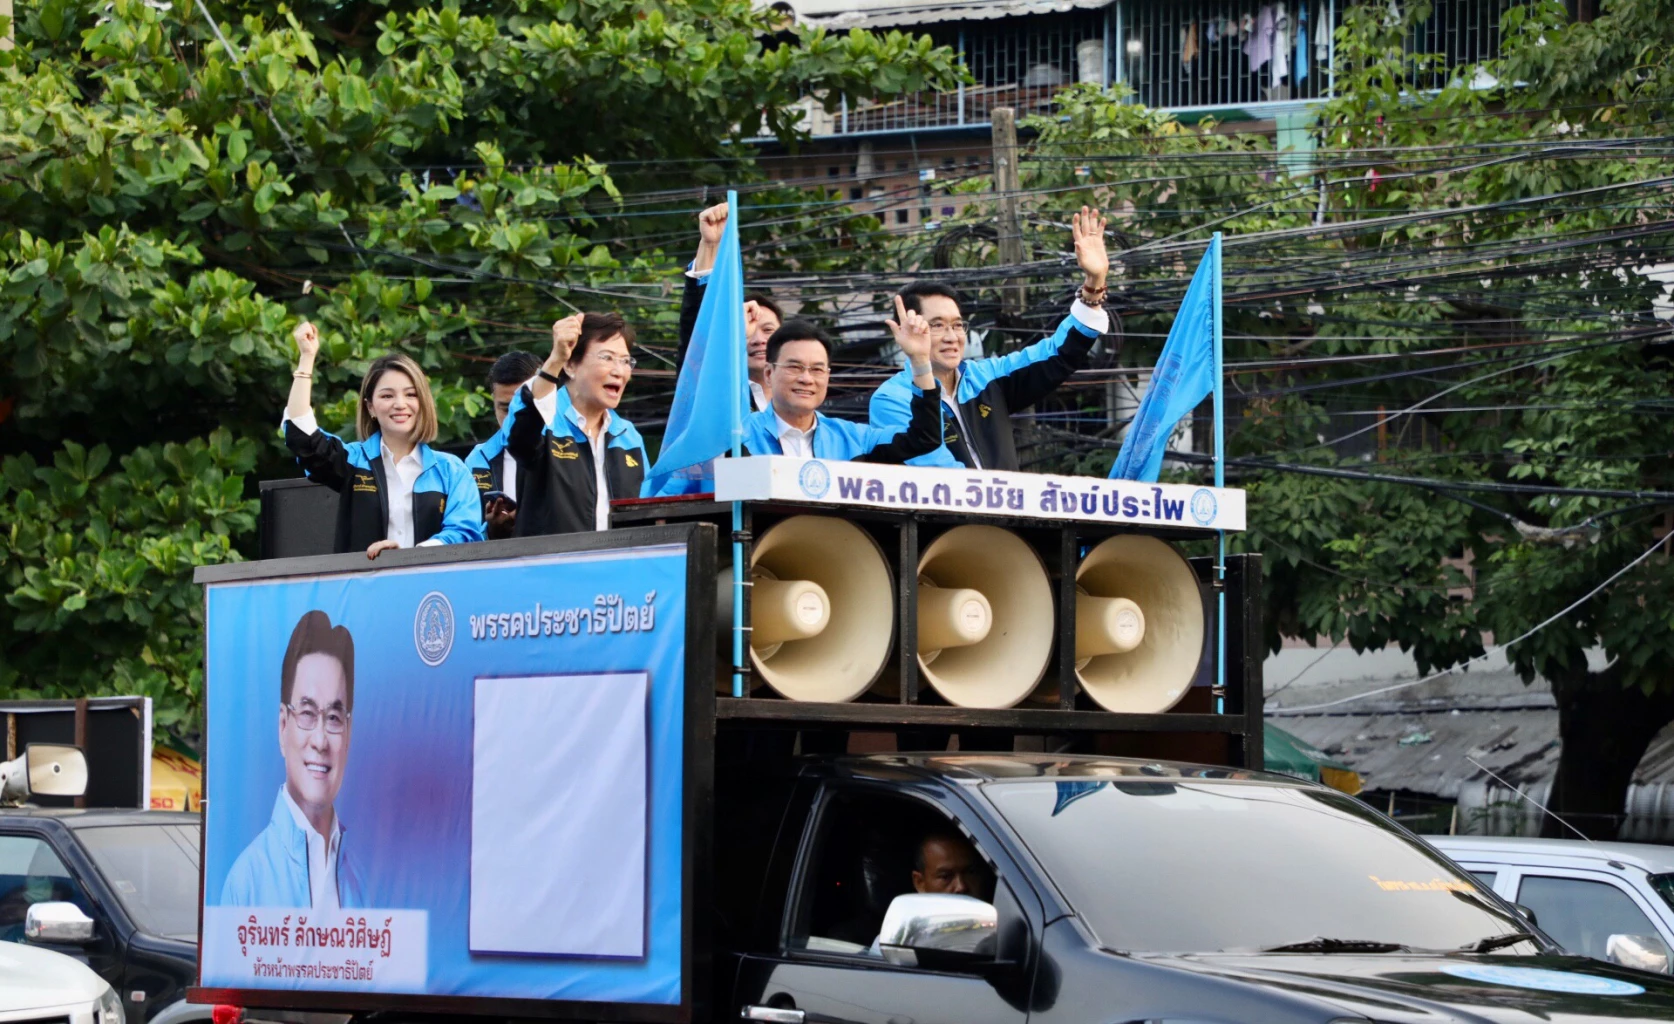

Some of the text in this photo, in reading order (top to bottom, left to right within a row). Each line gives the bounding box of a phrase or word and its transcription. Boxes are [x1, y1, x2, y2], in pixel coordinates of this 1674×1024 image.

[837, 475, 1024, 510] พล.ต.ต.วิชัย
[1039, 480, 1185, 521] สังข์ประไพ
[469, 589, 657, 640] พรรคประชาธิปัตย์
[237, 914, 392, 958] จุรินทร์ ลักษณวิศิษฏ์
[253, 956, 374, 981] หัวหน้าพรรคประชาธิปัตย์
